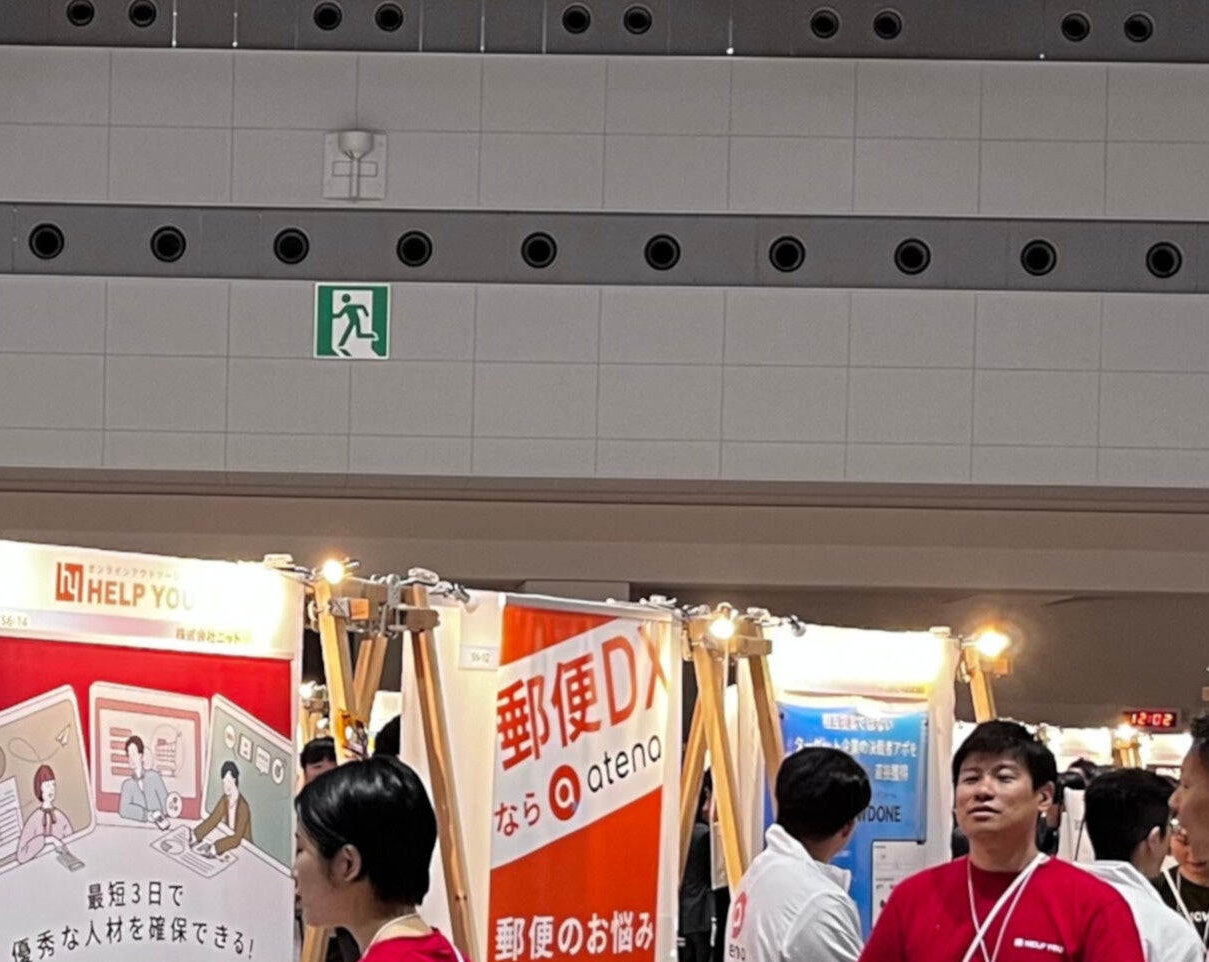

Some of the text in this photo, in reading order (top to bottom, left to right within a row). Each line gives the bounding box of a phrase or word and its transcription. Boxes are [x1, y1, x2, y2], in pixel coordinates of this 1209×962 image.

[87, 579, 195, 611] HELP YOU
[1131, 713, 1173, 727] 12:02
[494, 792, 541, 837] なら
[587, 735, 662, 793] atena
[88, 881, 184, 910] 最短3日で
[494, 910, 654, 962] 郵便のお悩み
